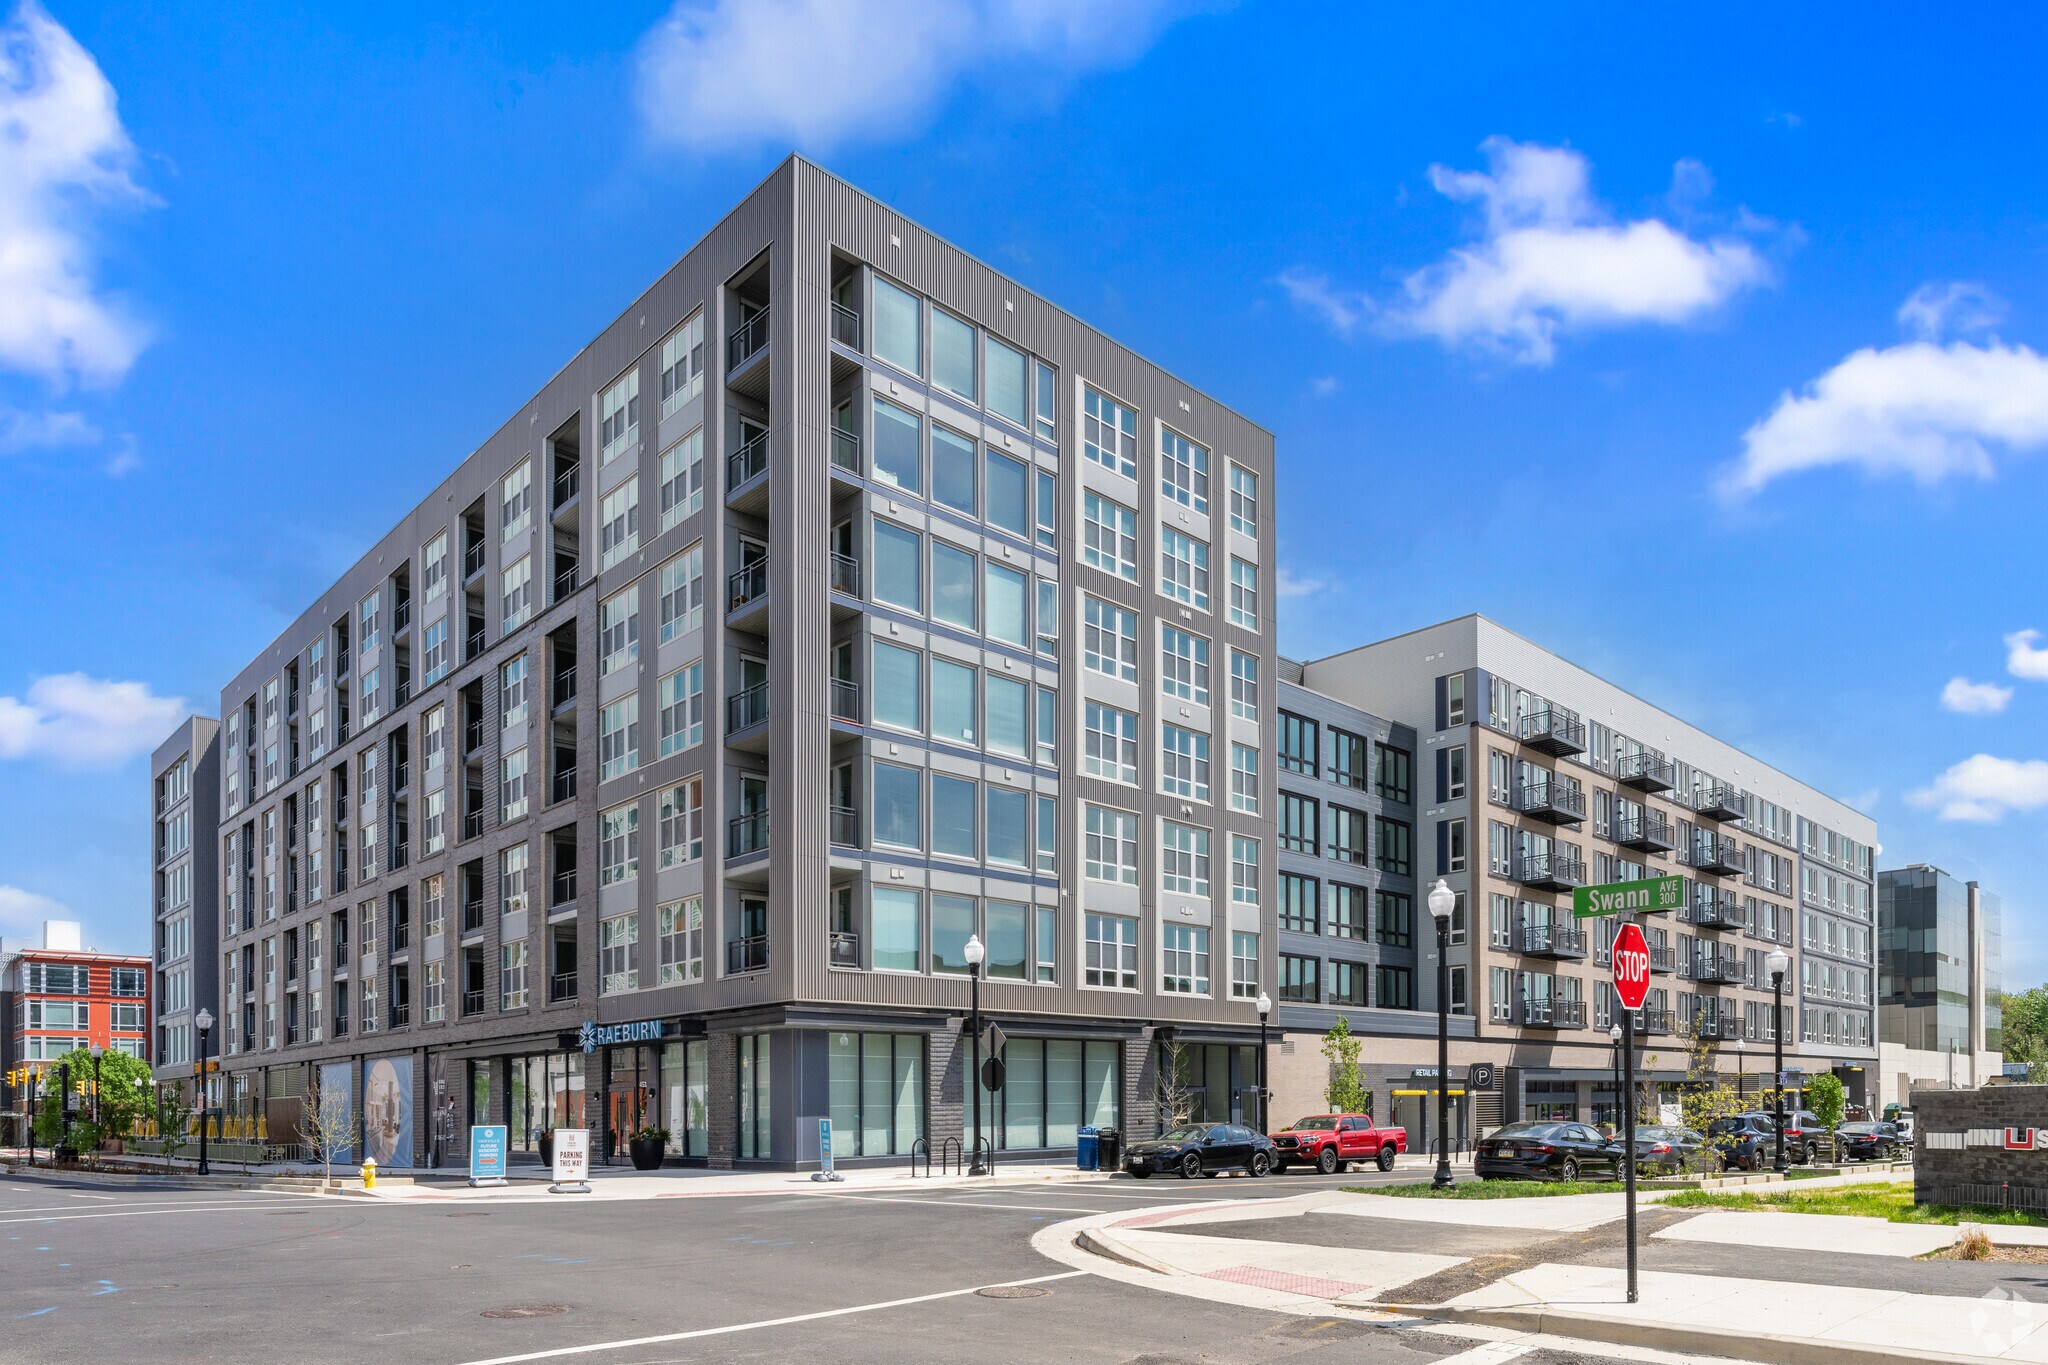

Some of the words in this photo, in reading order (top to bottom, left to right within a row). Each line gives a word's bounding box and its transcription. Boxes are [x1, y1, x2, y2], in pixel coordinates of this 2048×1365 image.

[1588, 889, 1650, 912] Swann
[1660, 879, 1678, 892] AVE
[1660, 892, 1676, 905] 300
[1615, 949, 1648, 983] STOP
[597, 1020, 662, 1045] RAEBURN
[1415, 1069, 1432, 1077] RETAIL
[560, 1151, 583, 1159] PARKING
